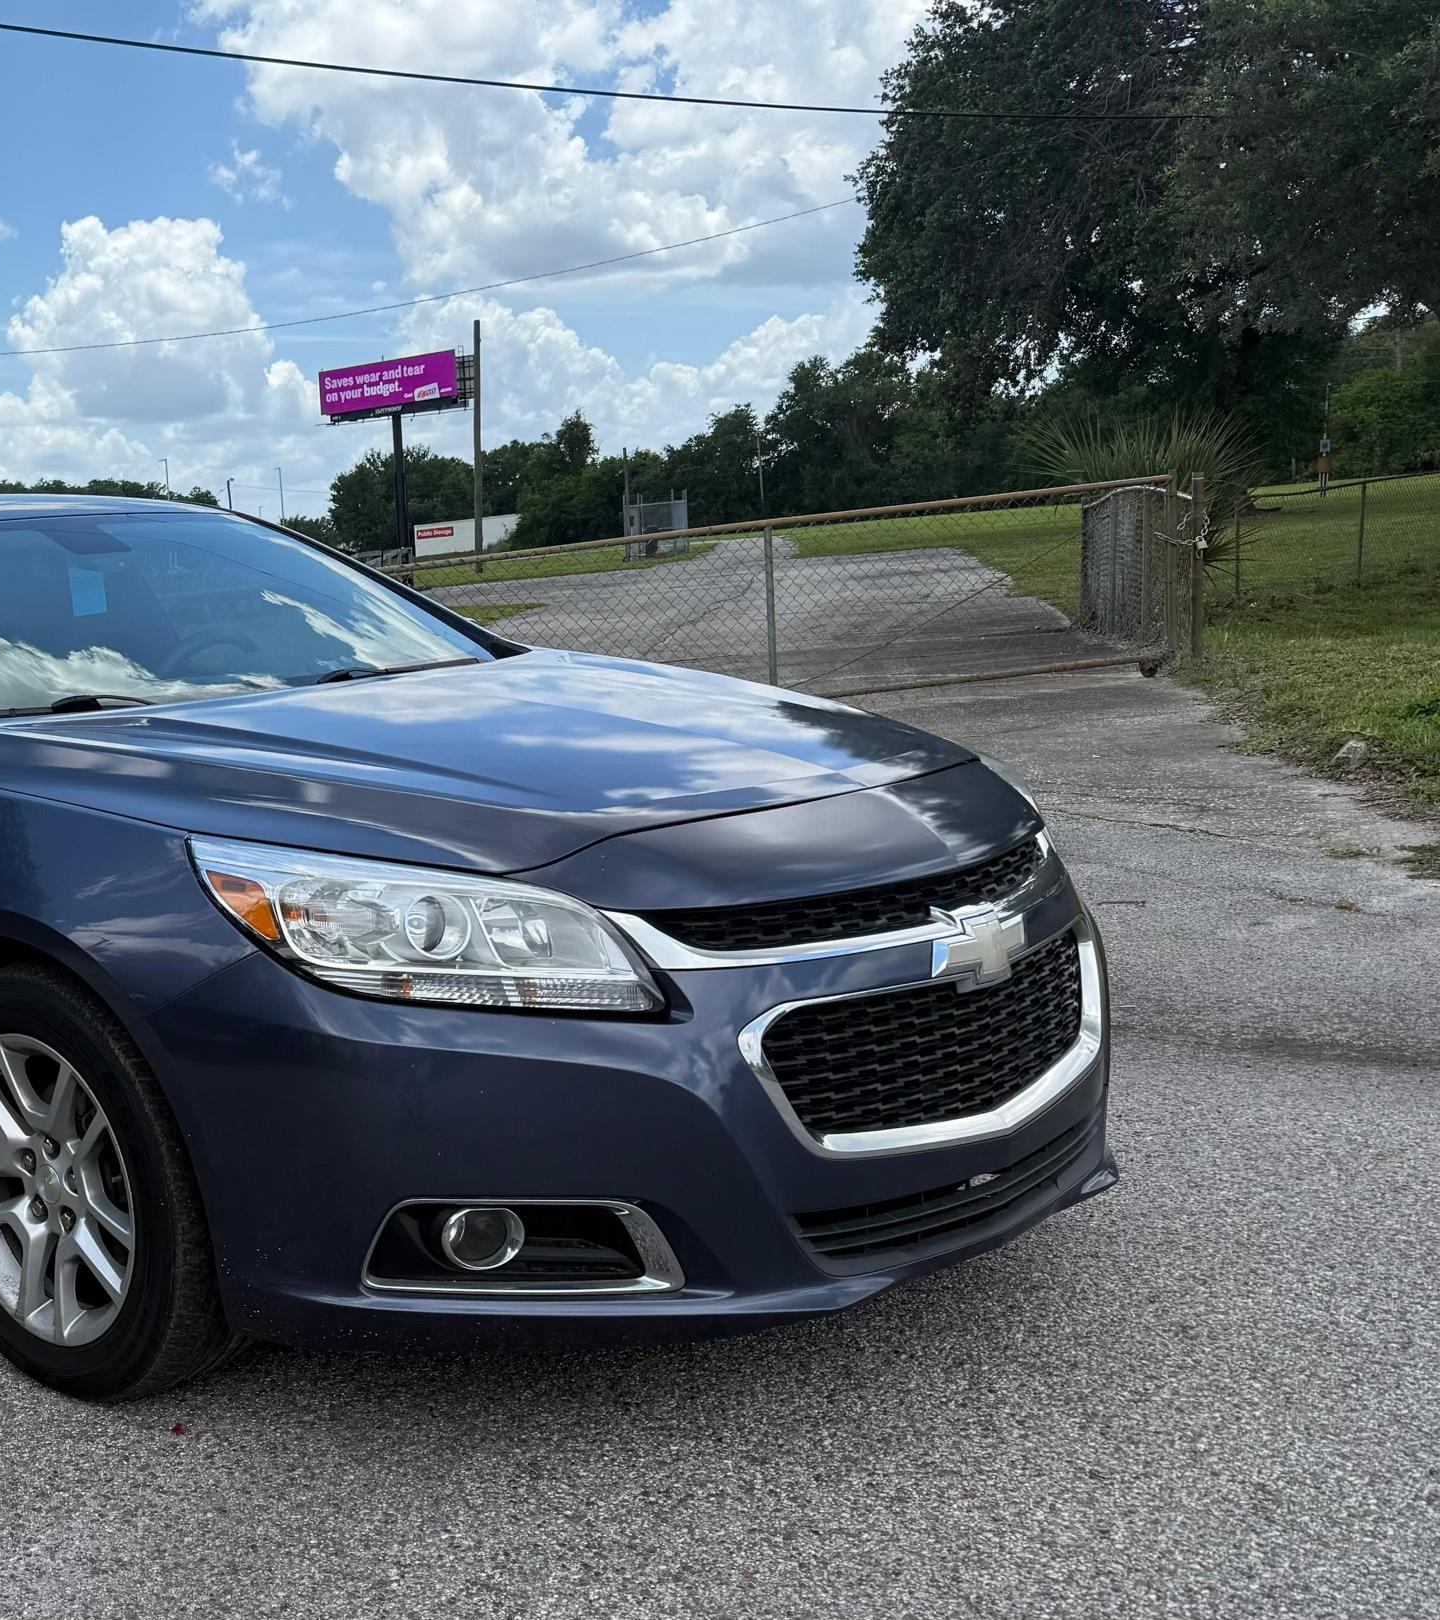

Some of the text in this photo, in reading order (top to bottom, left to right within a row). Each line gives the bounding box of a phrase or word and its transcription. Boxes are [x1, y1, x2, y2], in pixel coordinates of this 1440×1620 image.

[325, 364, 425, 390] Saves wear and tear
[326, 392, 338, 403] on
[339, 387, 363, 404] your
[363, 380, 403, 397] budget.
